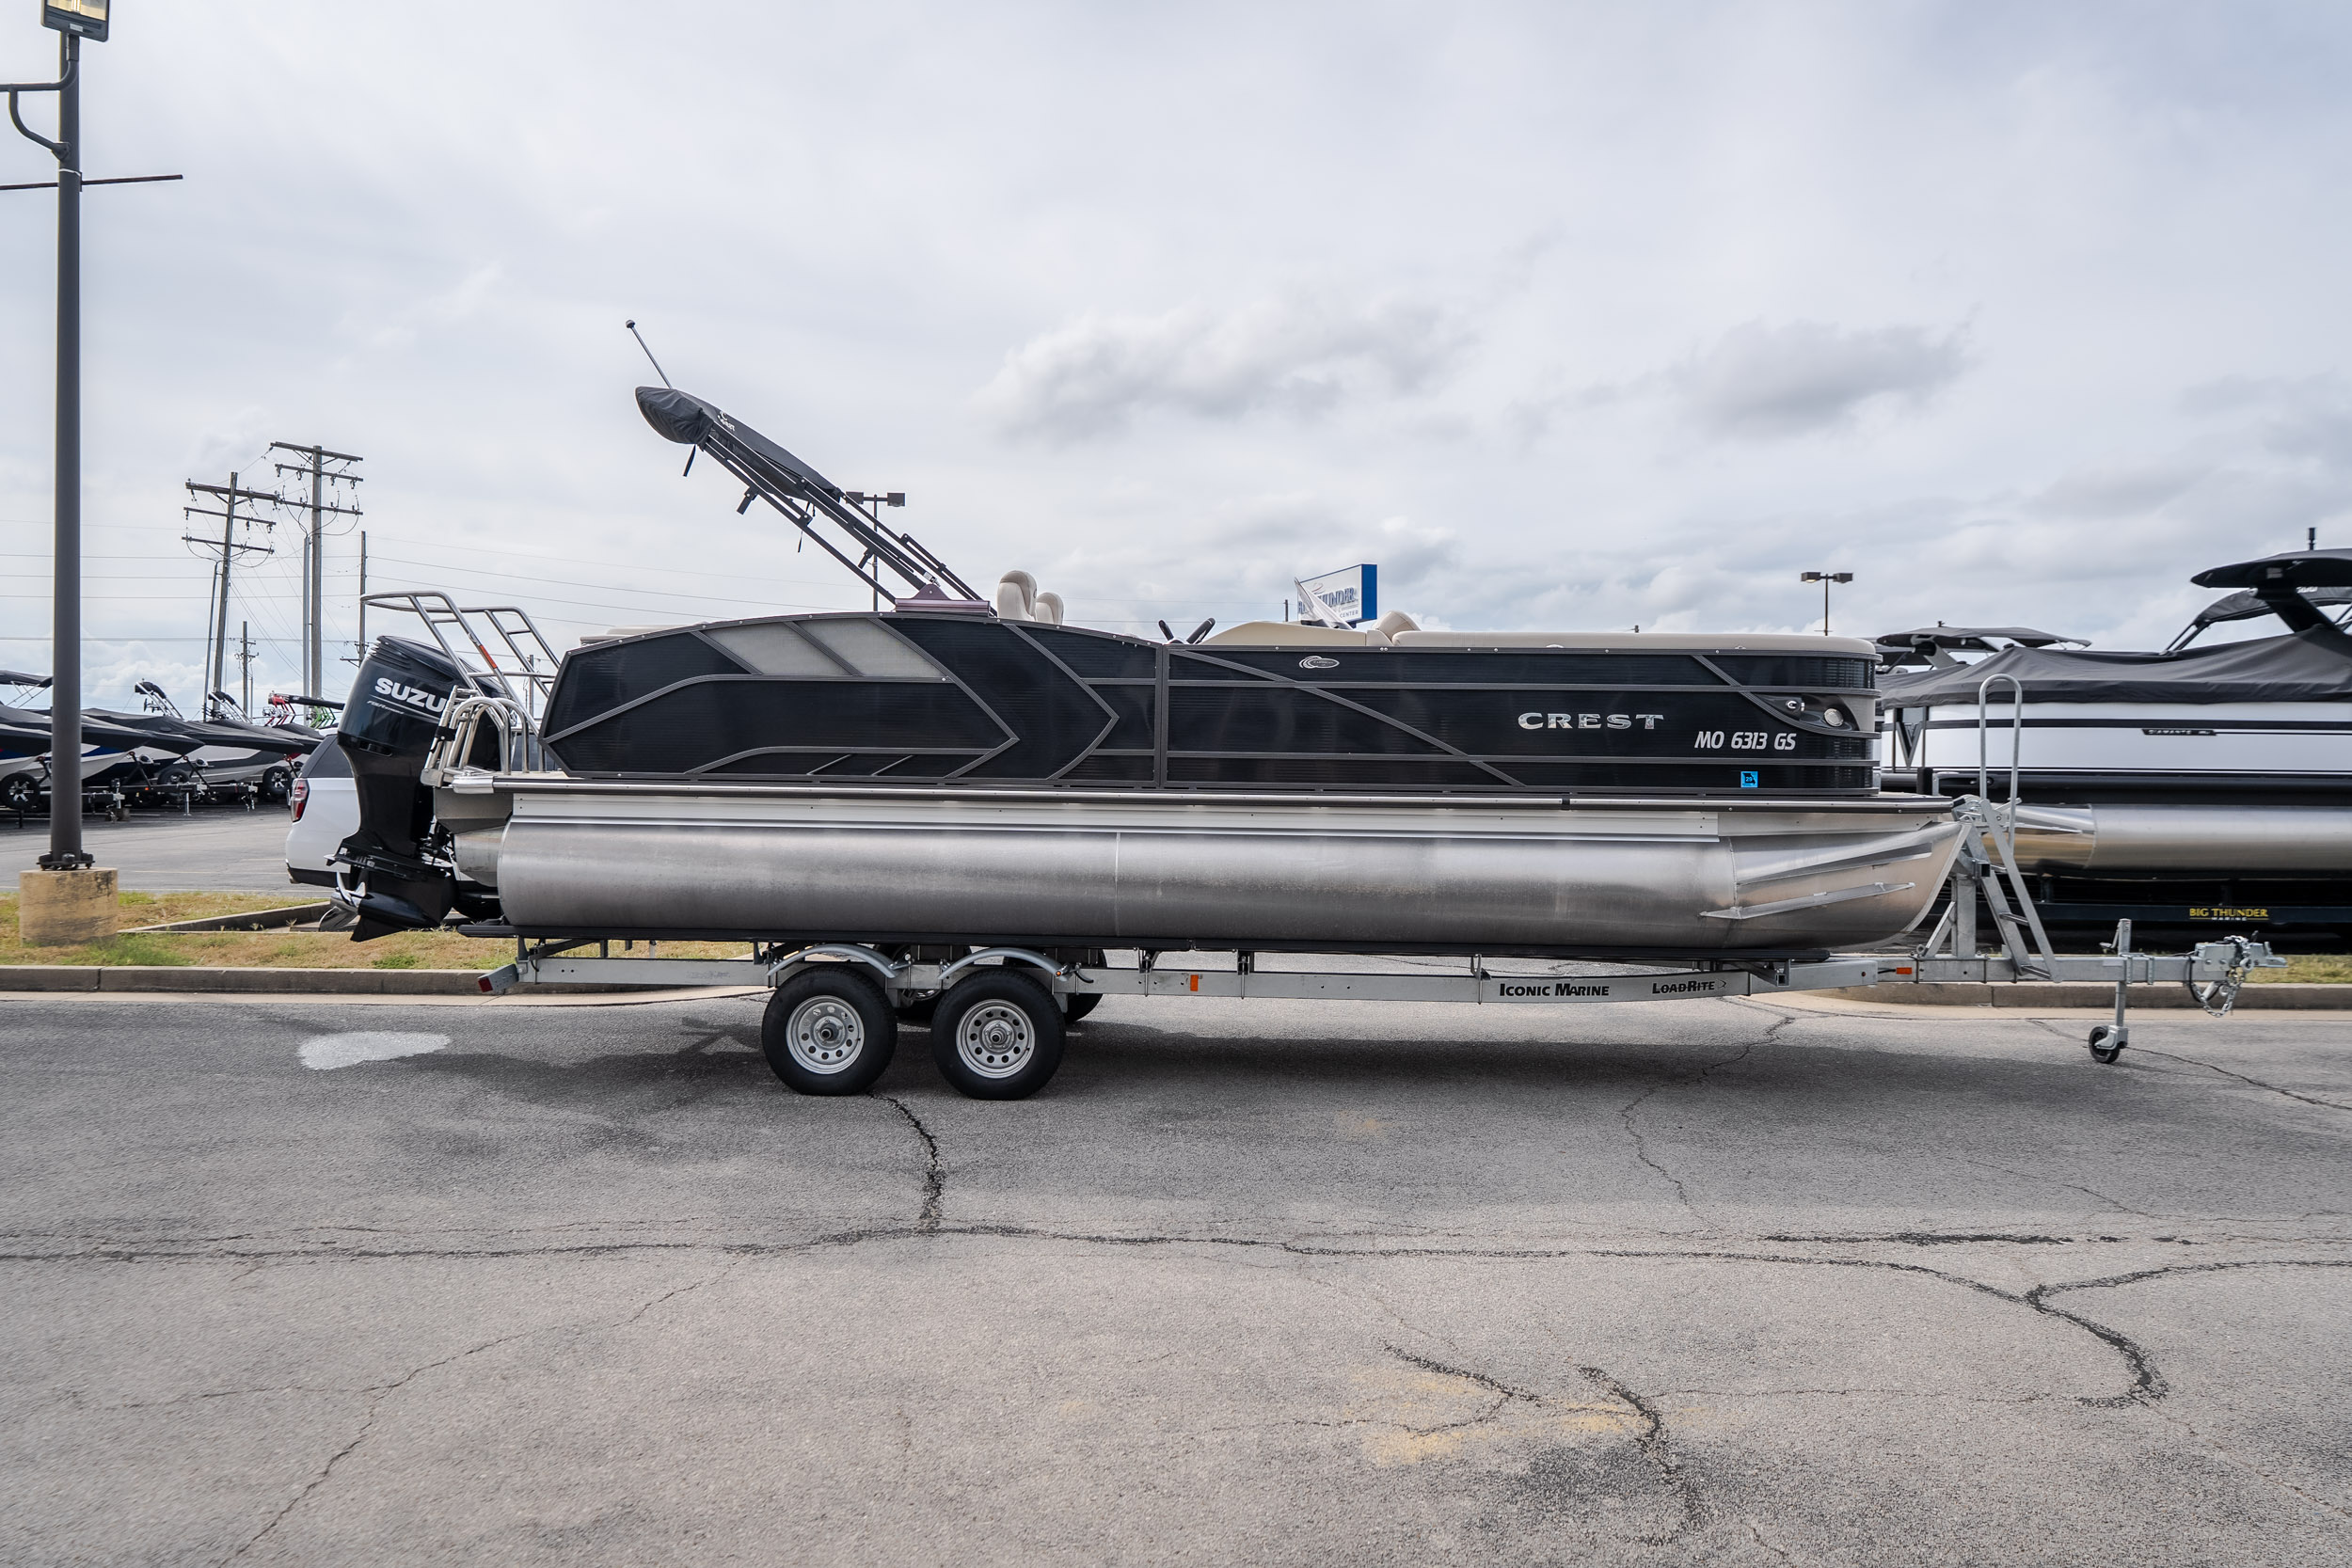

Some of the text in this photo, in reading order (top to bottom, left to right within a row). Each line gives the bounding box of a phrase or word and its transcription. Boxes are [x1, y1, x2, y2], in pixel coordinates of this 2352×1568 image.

[374, 677, 447, 712] SUZU
[1518, 712, 1664, 730] CREST
[1694, 731, 1797, 751] MO 6313 GS
[2189, 908, 2269, 917] BIG THUNDER
[1500, 983, 1610, 997] ICONIC MARINE
